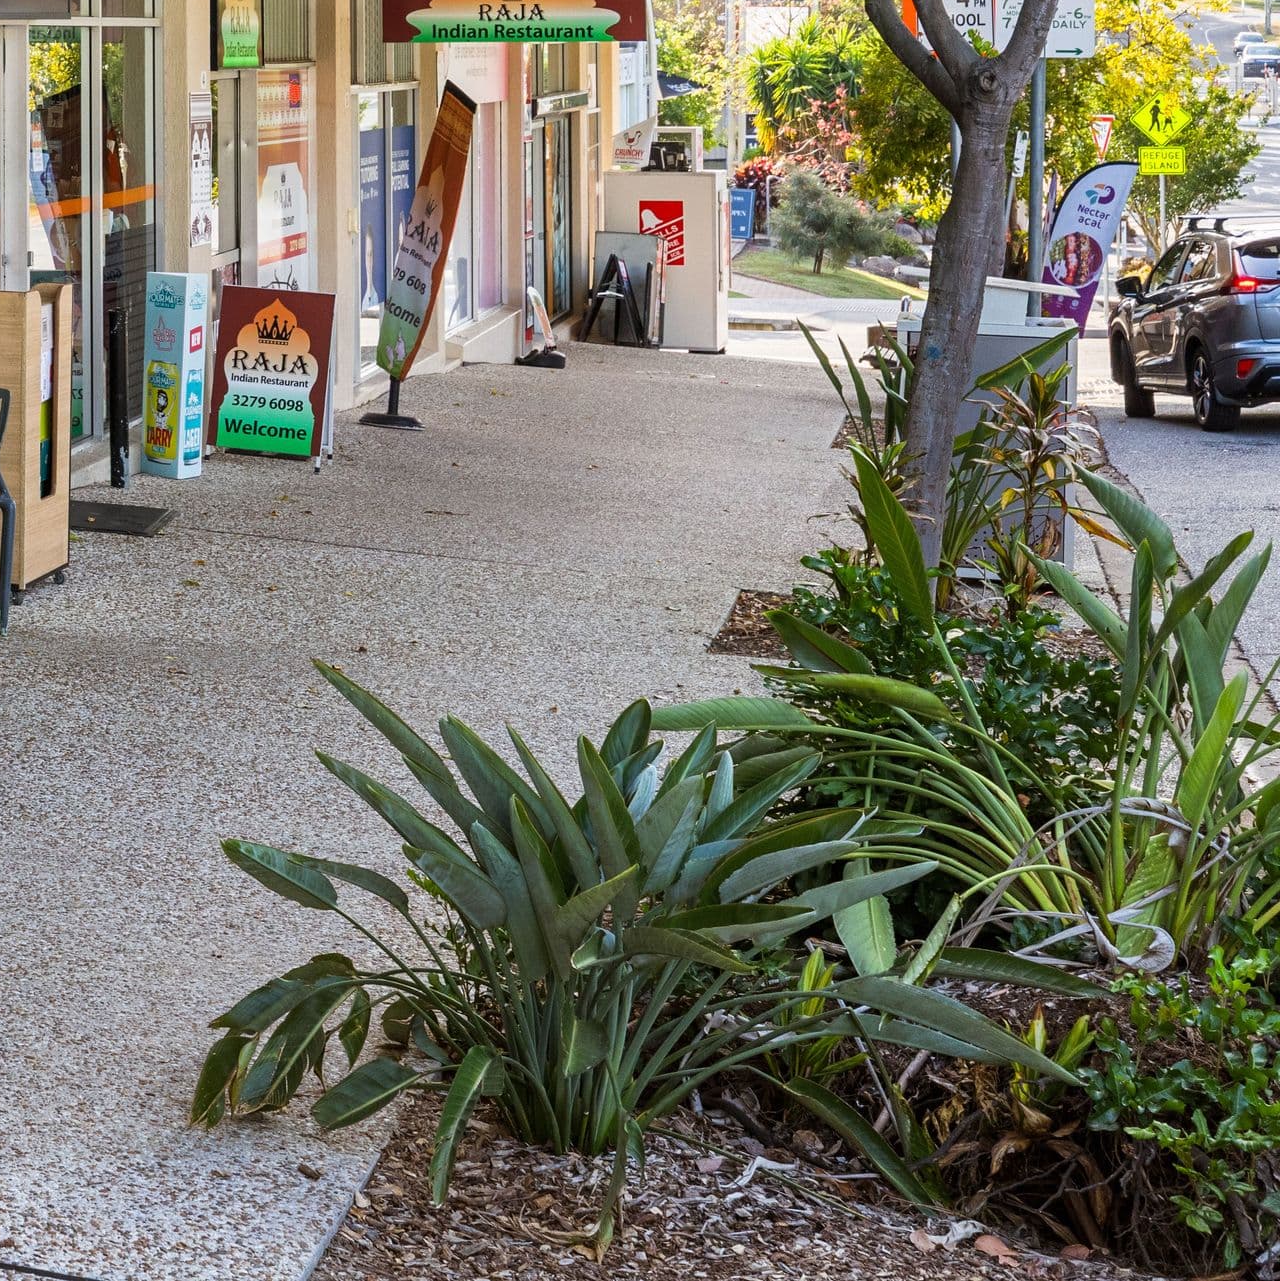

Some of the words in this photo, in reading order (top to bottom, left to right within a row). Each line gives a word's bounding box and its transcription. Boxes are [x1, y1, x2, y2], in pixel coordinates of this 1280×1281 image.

[478, 3, 545, 21] RAJA
[973, 0, 986, 8] PM
[432, 23, 491, 39] Indian
[494, 23, 594, 39] Restaurant
[1052, 19, 1088, 29] DAILY
[615, 148, 644, 159] CRUNCHY
[1143, 151, 1181, 160] REFUGE
[1144, 161, 1180, 170] ISLAND
[1077, 204, 1111, 221] Nectar
[231, 349, 310, 377] RAJA
[231, 372, 258, 386] Indian
[260, 375, 309, 389] Restaurant
[231, 394, 265, 409] 3279
[268, 398, 304, 412] 6098
[224, 416, 307, 441] Welcome
[147, 427, 173, 448] LARRY
